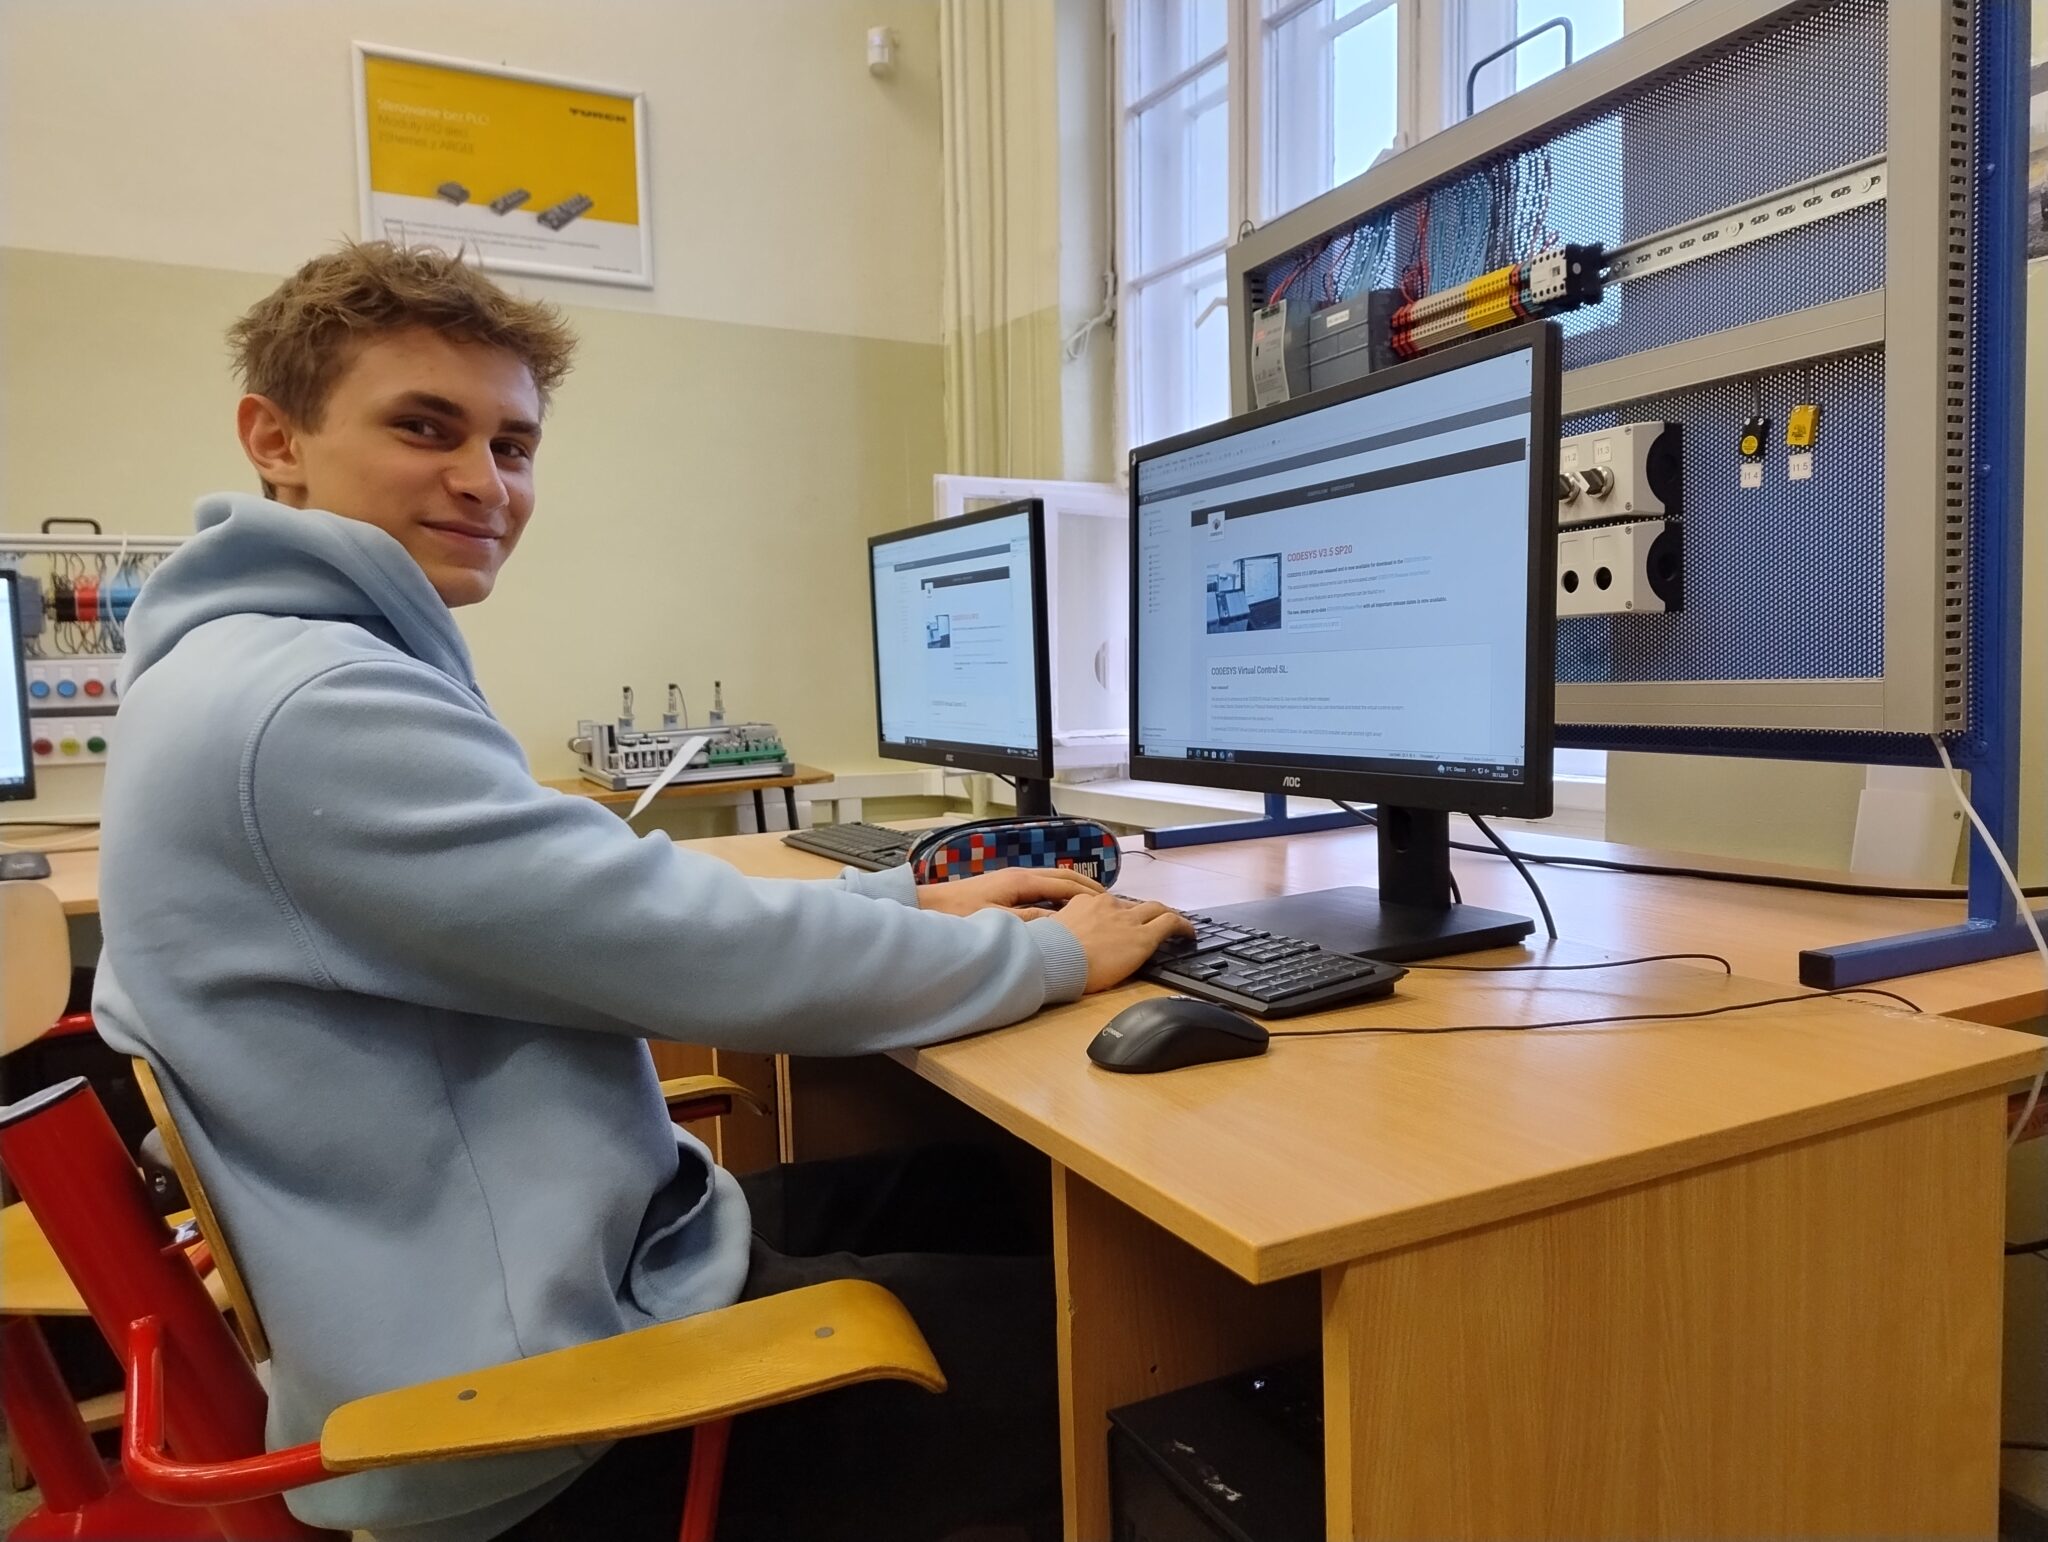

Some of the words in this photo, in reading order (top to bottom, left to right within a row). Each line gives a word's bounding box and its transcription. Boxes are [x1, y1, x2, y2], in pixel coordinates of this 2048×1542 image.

[1287, 549, 1318, 562] CODESYS
[1318, 546, 1334, 558] V3.5
[1335, 544, 1353, 556] SP20
[1238, 665, 1256, 675] Virtual
[1257, 664, 1278, 674] Control
[1282, 775, 1301, 788] AOC
